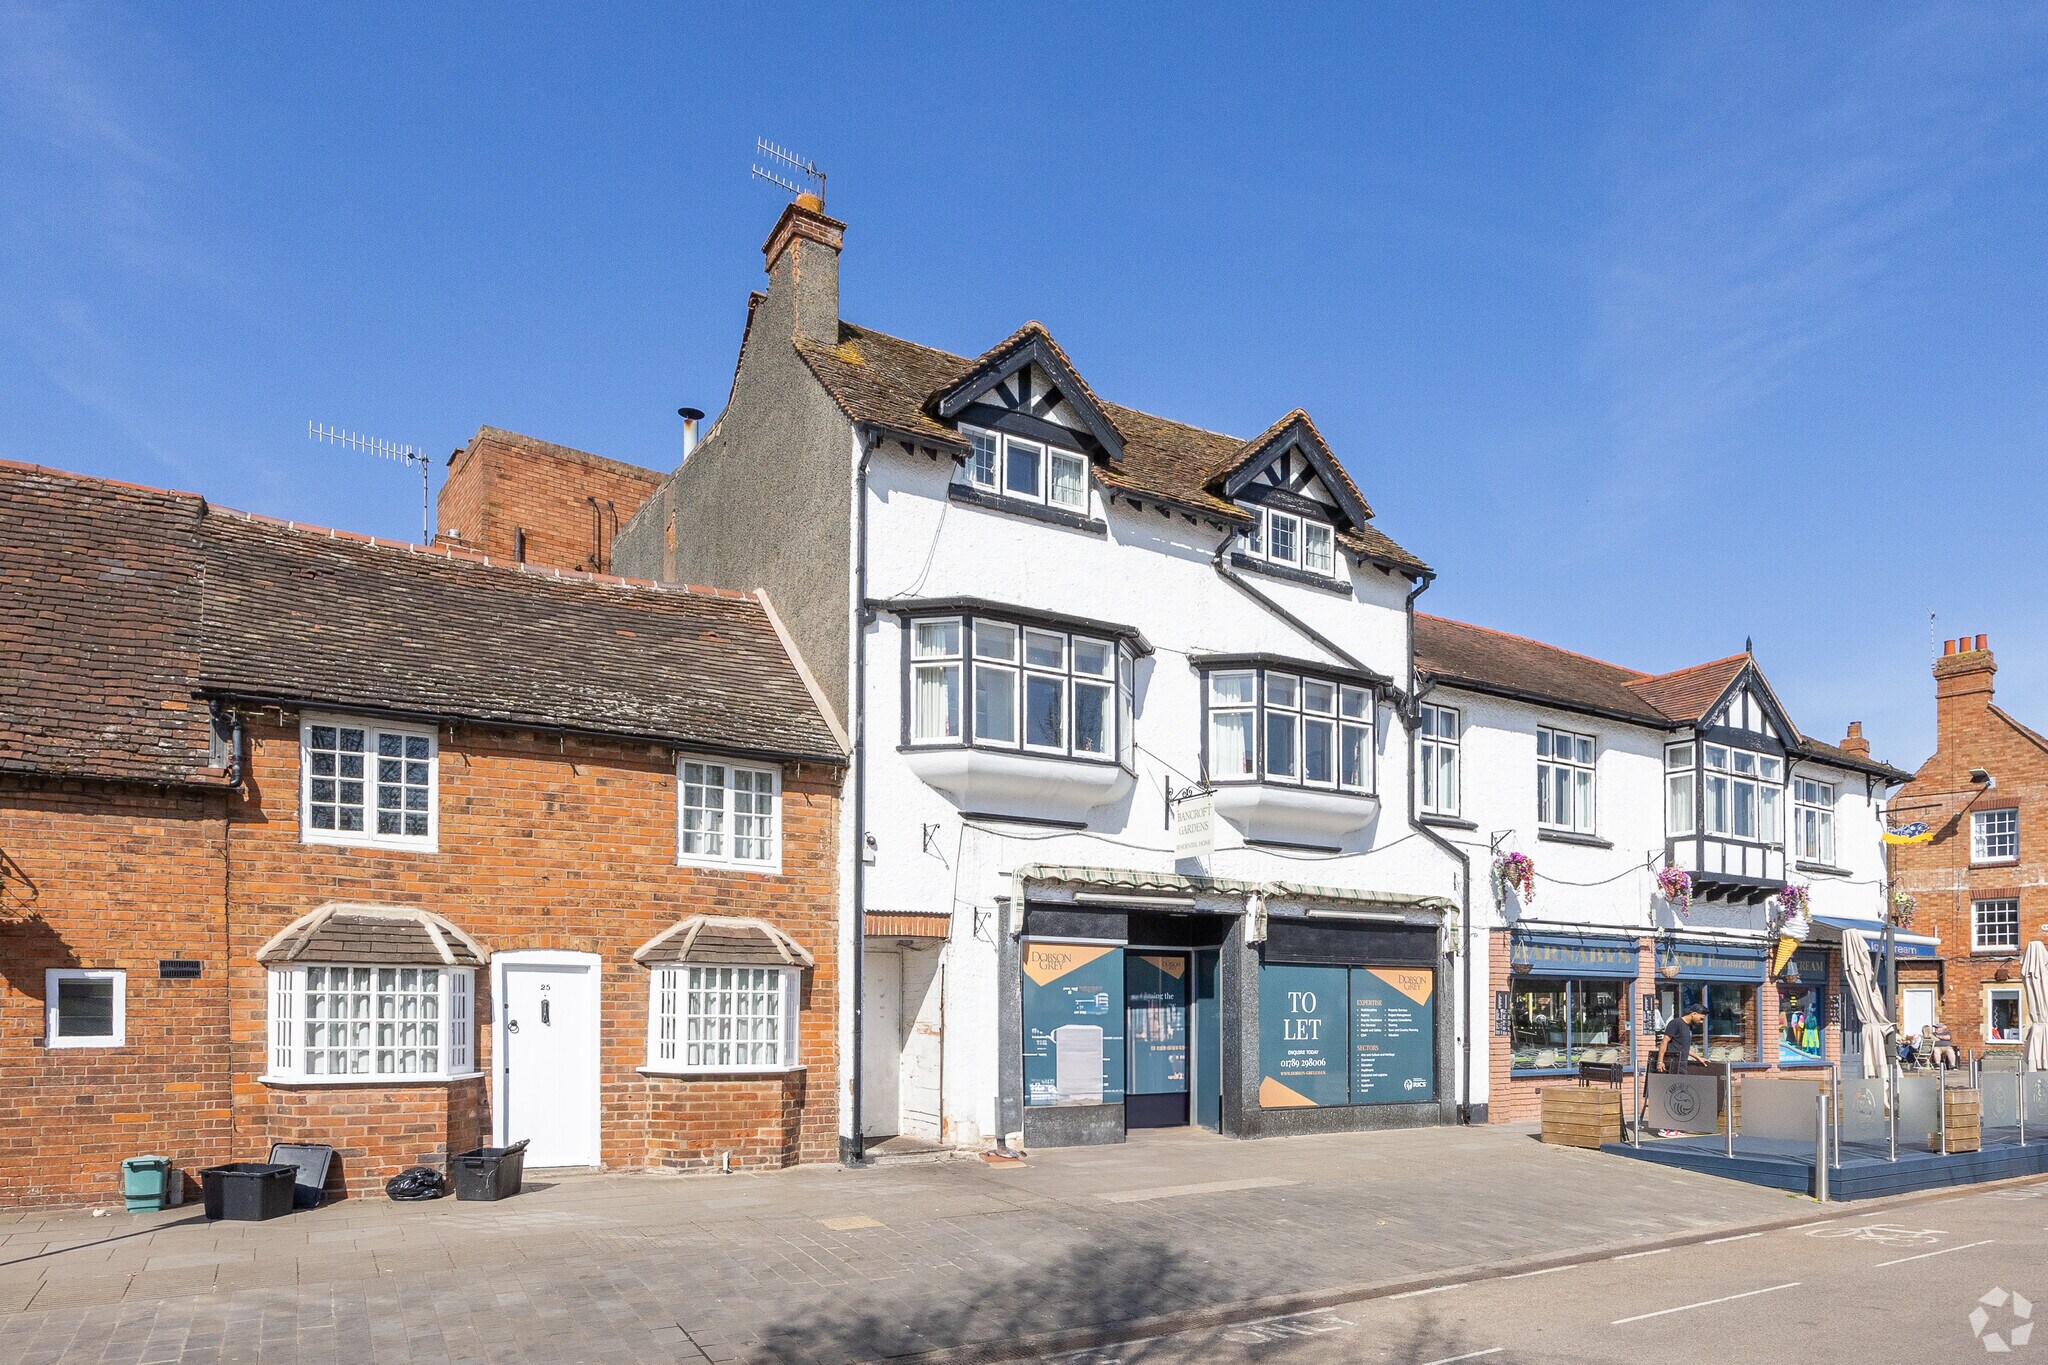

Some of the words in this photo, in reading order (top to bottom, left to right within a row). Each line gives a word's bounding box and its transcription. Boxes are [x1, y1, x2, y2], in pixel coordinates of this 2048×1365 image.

[1177, 807, 1212, 822] BANCROFT
[1178, 821, 1209, 835] GARDENS
[1894, 945, 1917, 954] ream
[1032, 951, 1072, 963] DOBSON
[1661, 951, 1703, 968] FISH
[1708, 954, 1756, 970] Restaurant
[1039, 961, 1065, 971] GREY
[1398, 975, 1427, 984] DOBSON
[1403, 982, 1421, 991] GREY
[1164, 992, 1175, 1000] the
[1288, 992, 1317, 1013] TO
[1283, 1019, 1322, 1040] LET
[1280, 1058, 1300, 1068] 01789
[1301, 1058, 1326, 1067] 298006
